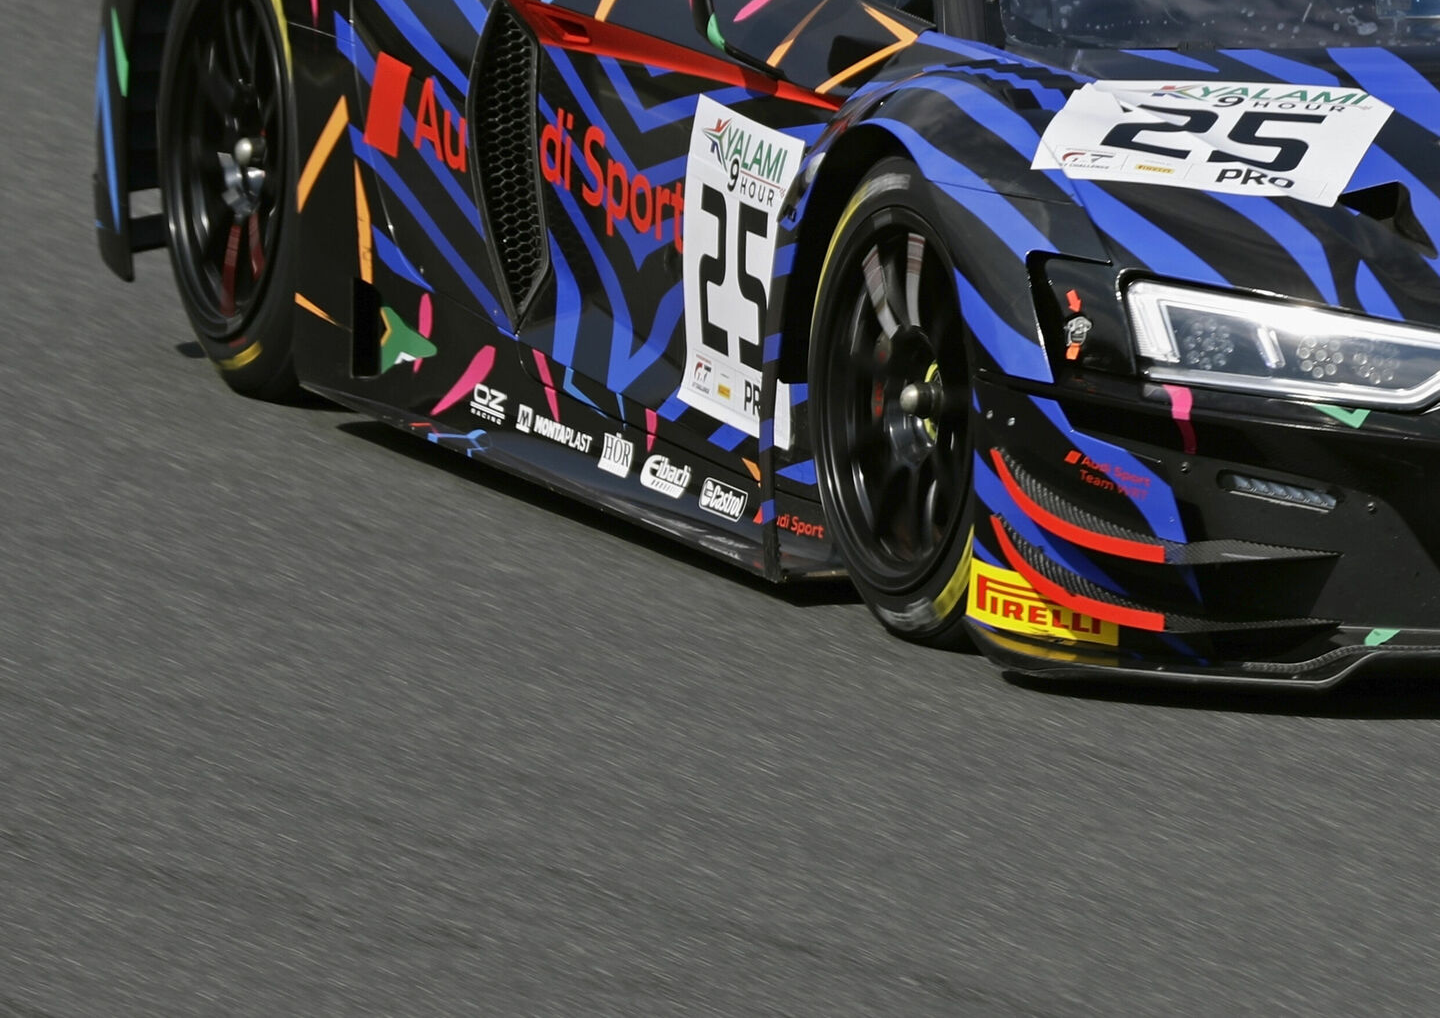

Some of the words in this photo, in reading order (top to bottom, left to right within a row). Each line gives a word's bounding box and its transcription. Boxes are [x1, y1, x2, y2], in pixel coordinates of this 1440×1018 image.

[1151, 84, 1372, 107] KYALAMI
[1213, 95, 1245, 109] 9
[1252, 100, 1346, 113] HOUR
[702, 118, 788, 182] KYALAMI
[1100, 103, 1328, 173] 25
[413, 77, 573, 191] Audi
[582, 125, 685, 254] Sport
[726, 158, 741, 192] 9
[740, 180, 775, 207] HOUR
[1214, 167, 1296, 189] PRO
[699, 182, 769, 373] 25
[744, 379, 762, 419] PR
[470, 407, 504, 426] RACING
[533, 414, 593, 454] MONTAPLAST
[1080, 469, 1115, 491] Team
[1081, 456, 1111, 473] Audi
[709, 484, 744, 518] Castrol
[790, 516, 825, 539] Sport
